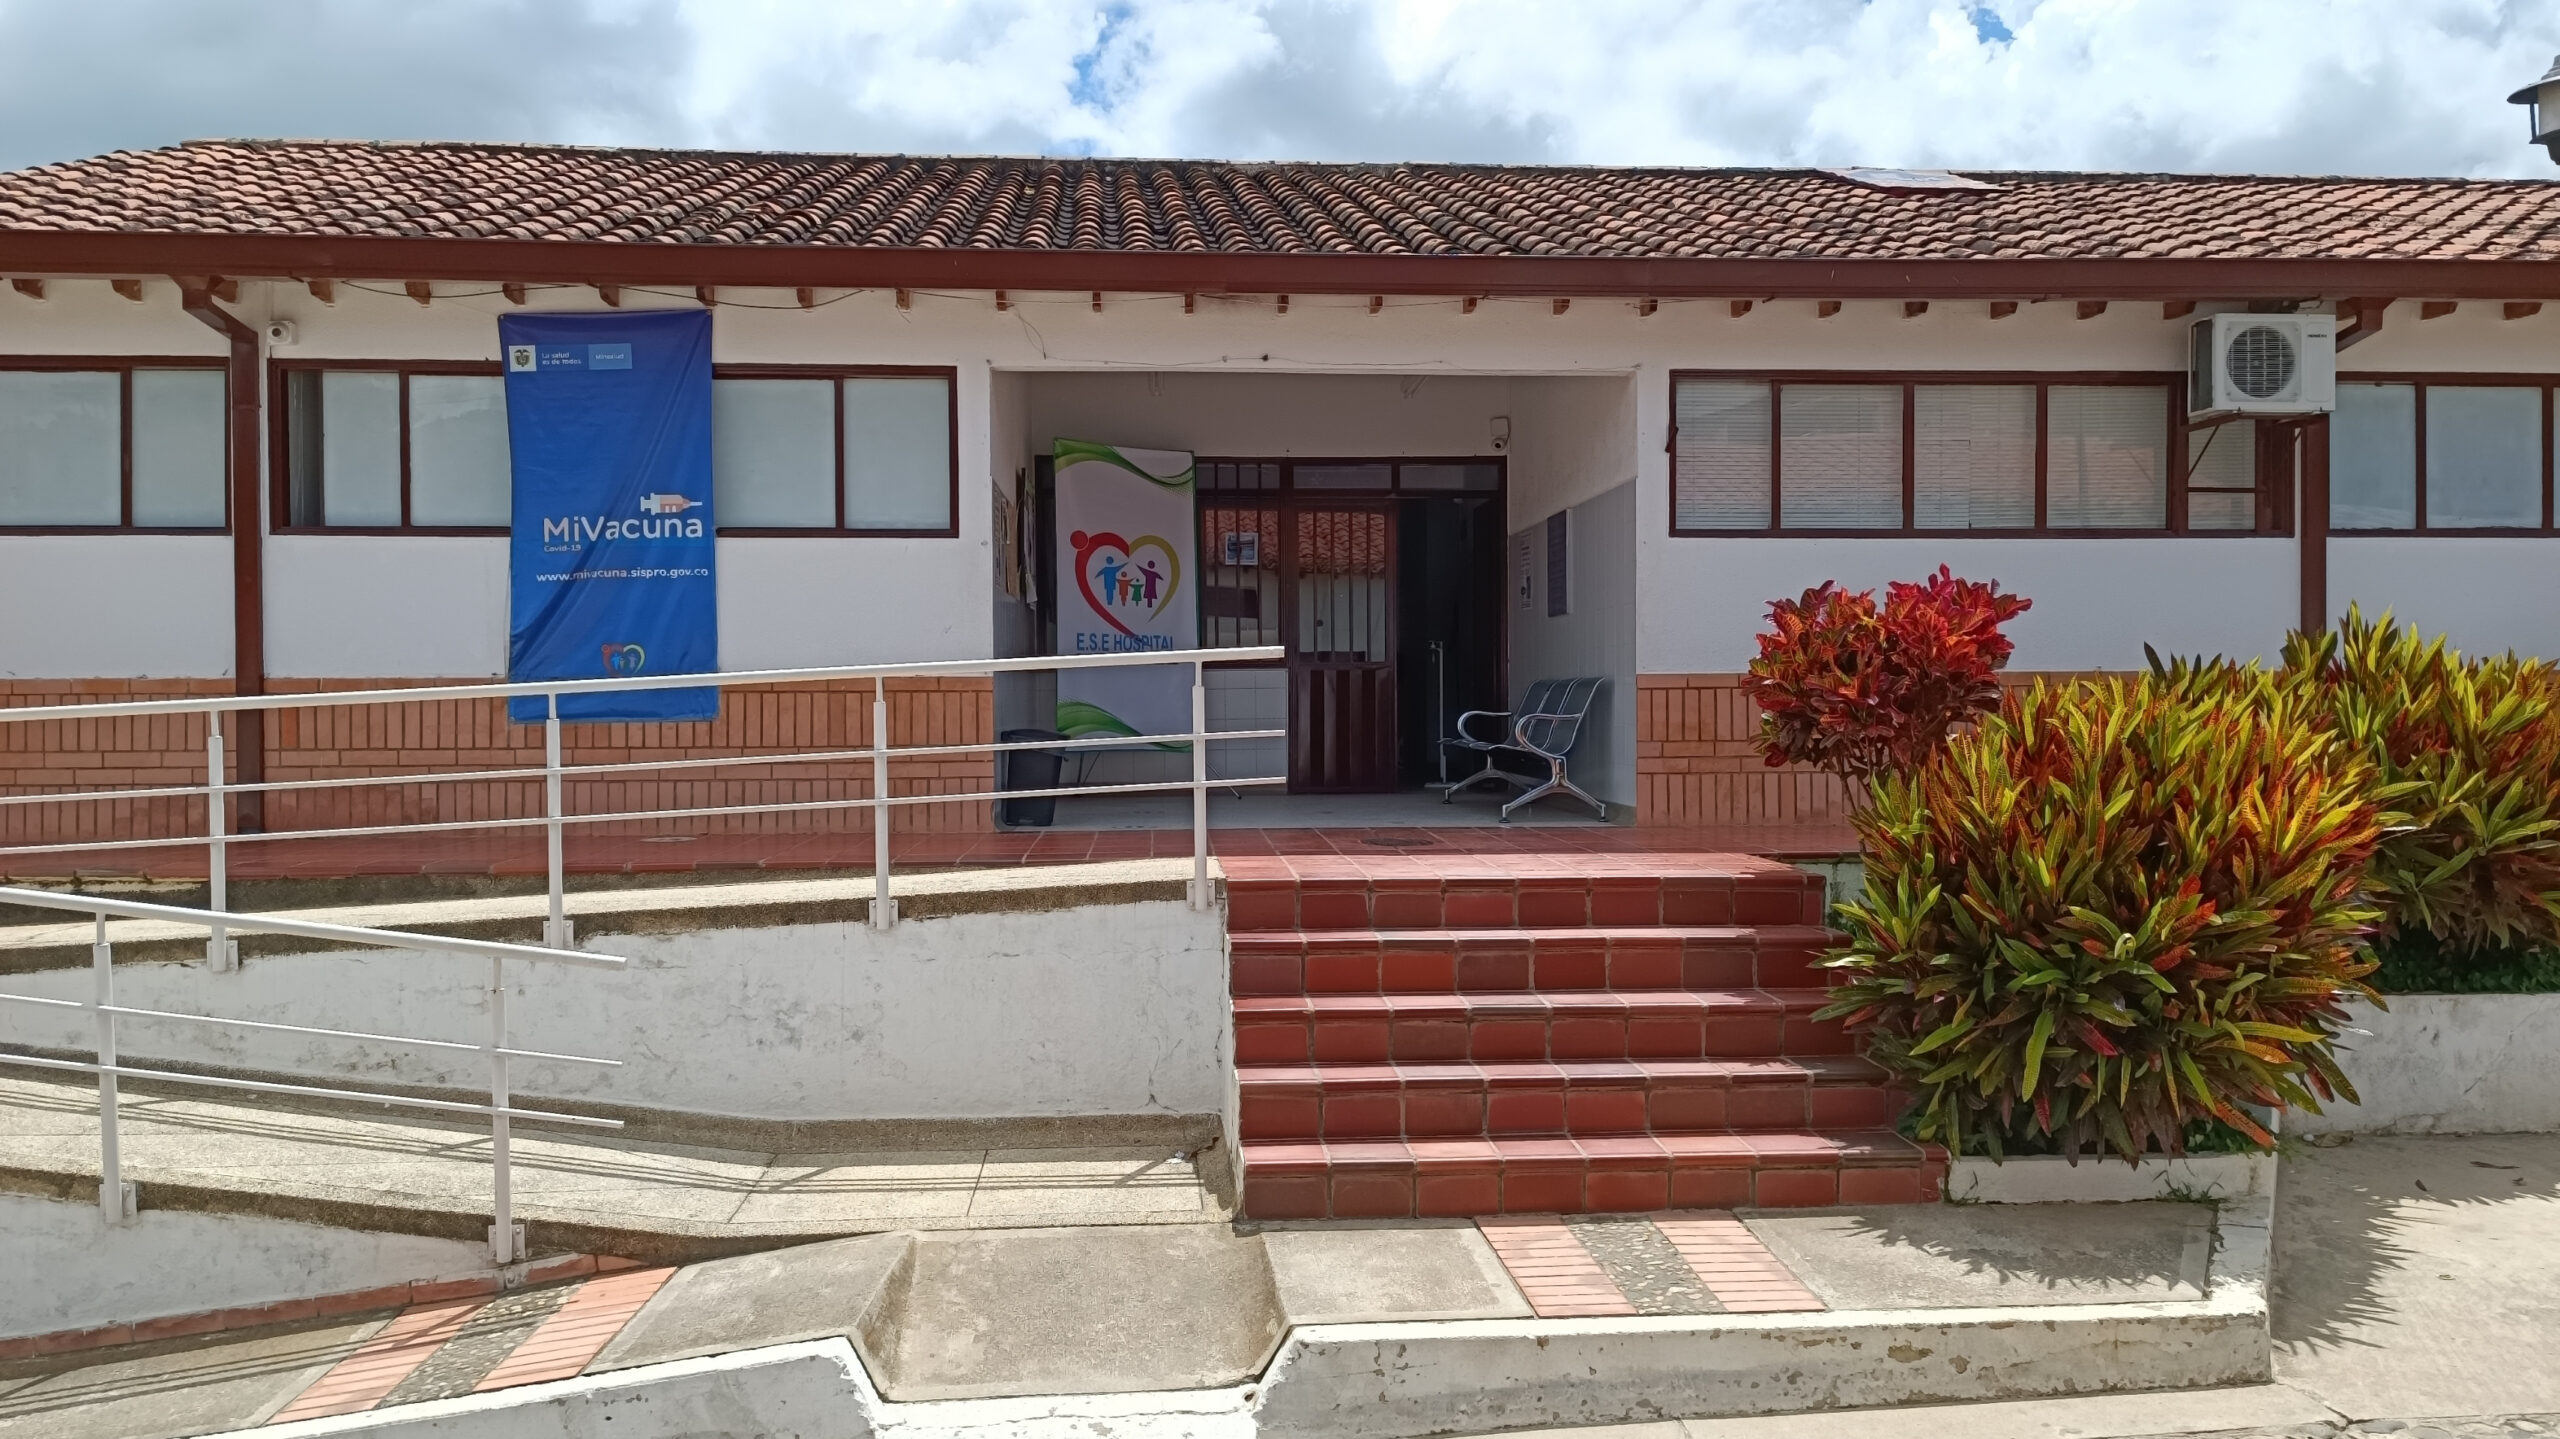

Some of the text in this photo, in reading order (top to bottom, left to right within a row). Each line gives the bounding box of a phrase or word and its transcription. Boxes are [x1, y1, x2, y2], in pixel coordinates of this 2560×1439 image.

[543, 516, 703, 543] MiVacuna
[544, 544, 581, 552] Covid-19
[536, 567, 709, 582] www.mivacuna.sispro.gov.co
